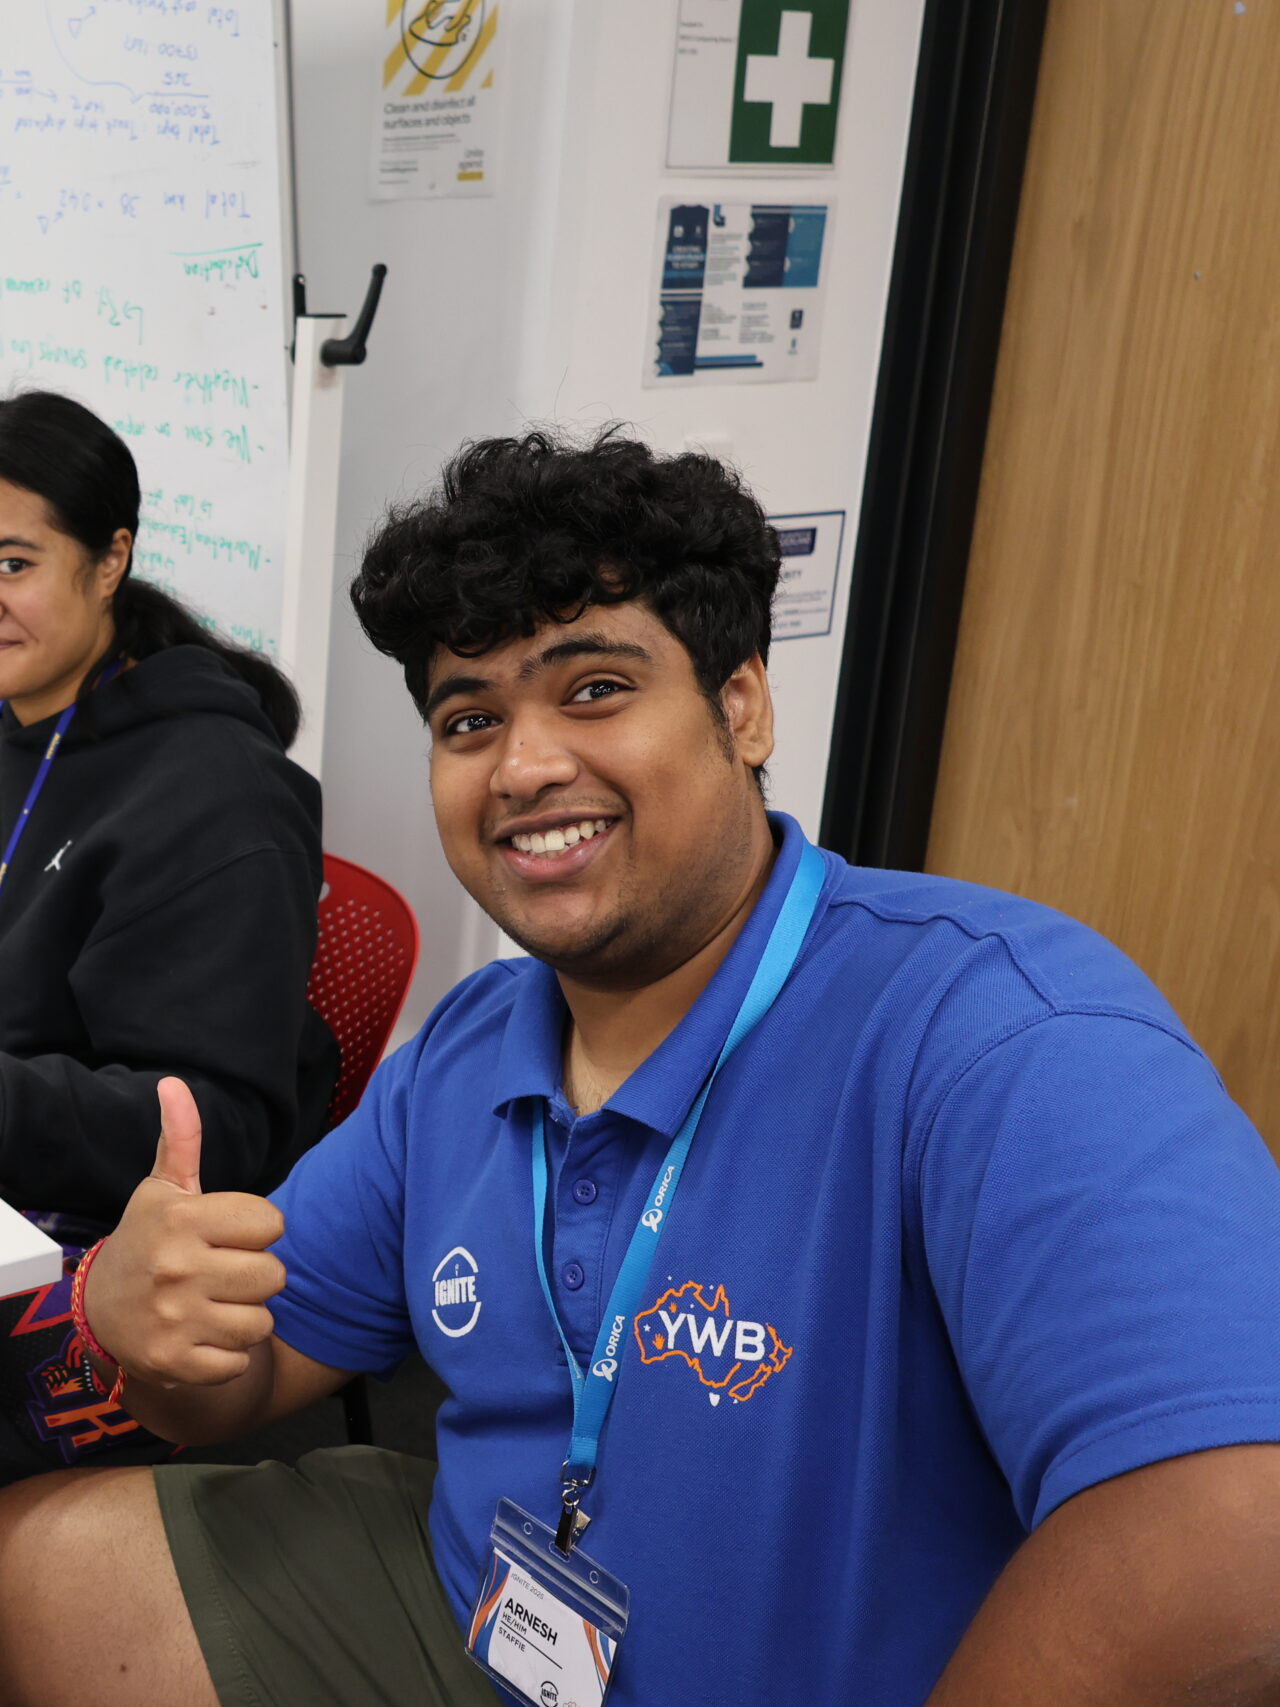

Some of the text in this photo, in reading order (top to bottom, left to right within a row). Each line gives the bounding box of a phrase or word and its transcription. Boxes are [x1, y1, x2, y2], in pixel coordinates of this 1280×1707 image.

[383, 113, 472, 129] surfaces and objects
[384, 102, 410, 114] Clean
[413, 101, 429, 112] and
[654, 1165, 675, 1207] ORICA
[435, 1275, 477, 1306] IGNITE
[605, 1315, 625, 1357] ORICA
[658, 1310, 766, 1362] YWB
[511, 1573, 530, 1591] IGNITE
[502, 1612, 527, 1635] HE/HIM
[504, 1598, 558, 1646] ARNESH
[498, 1627, 526, 1653] STAFFIE
